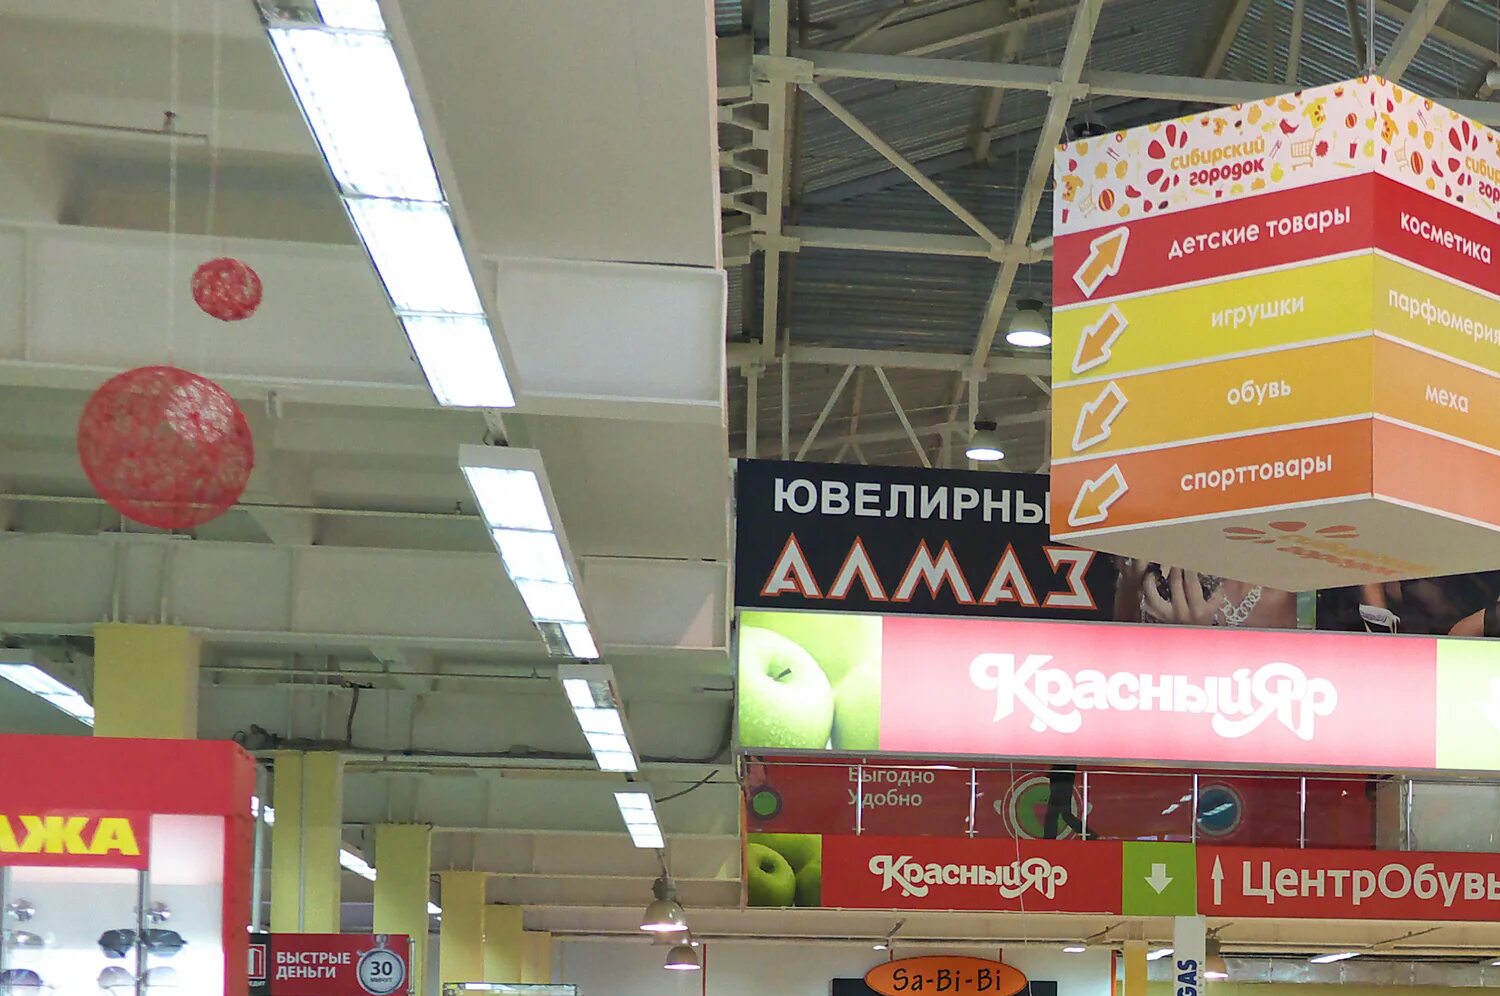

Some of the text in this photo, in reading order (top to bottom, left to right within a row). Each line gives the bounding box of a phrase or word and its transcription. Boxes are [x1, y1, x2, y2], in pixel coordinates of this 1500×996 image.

[1170, 137, 1266, 172] сибирский
[1189, 156, 1265, 187] городок
[1168, 205, 1351, 259] детские товары
[1400, 211, 1492, 265] косметика
[1211, 296, 1305, 330] игрушки
[1227, 380, 1291, 406] обувь
[1425, 385, 1469, 413] меха
[1181, 454, 1333, 492] спорттовары
[774, 478, 1050, 525] ЮВЕЛИРНЫ
[760, 532, 1098, 610] АЛМАЗ
[848, 767, 935, 786] Выгодно
[848, 789, 923, 809] Удобно
[276, 951, 351, 965] БЫСТРЫЕ
[370, 961, 393, 976] 30
[275, 966, 336, 980] ДЕНЬГИ
[892, 968, 1001, 992] Sa-Bi-Bi
